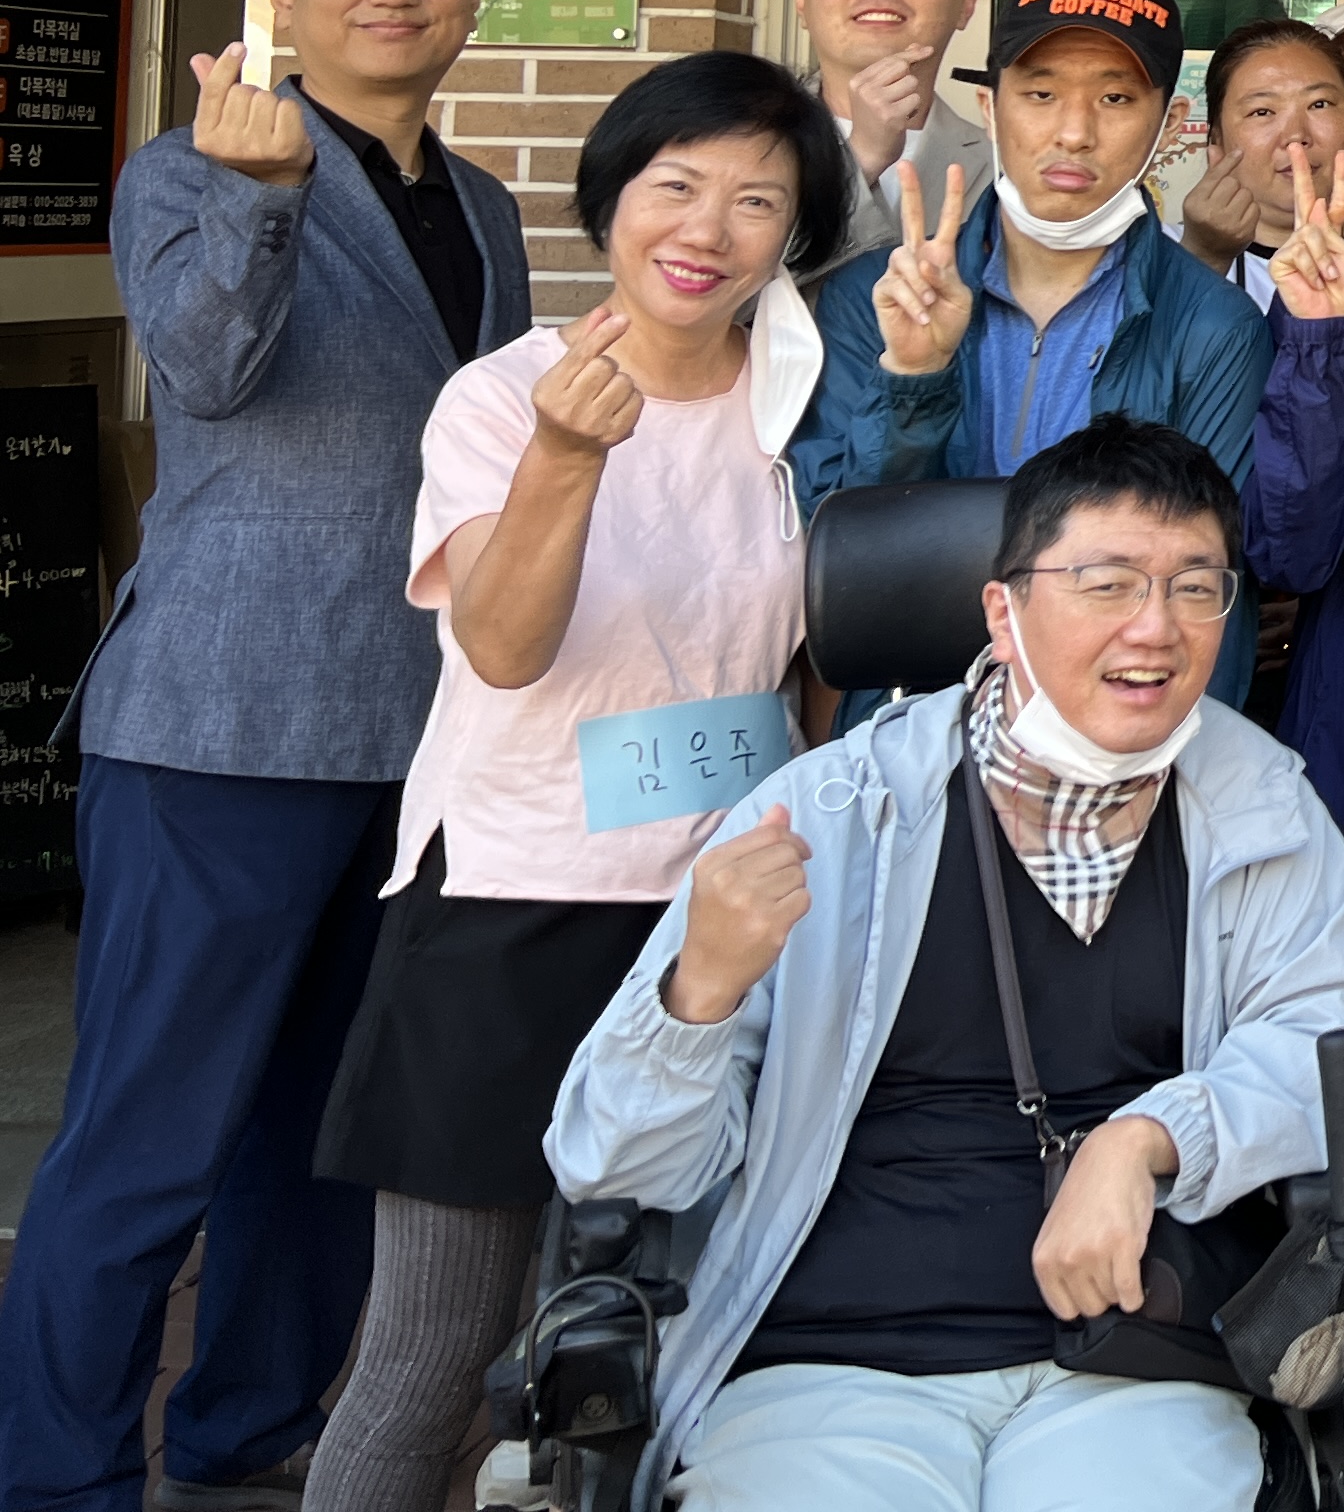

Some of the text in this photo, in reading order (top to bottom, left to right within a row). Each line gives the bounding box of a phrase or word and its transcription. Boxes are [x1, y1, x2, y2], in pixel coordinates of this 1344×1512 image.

[33, 18, 81, 41] 다목적실
[19, 76, 68, 98] 다목적실
[66, 104, 96, 122] 사무실
[8, 143, 43, 167] 옥 상
[622, 729, 757, 795] 김은주
